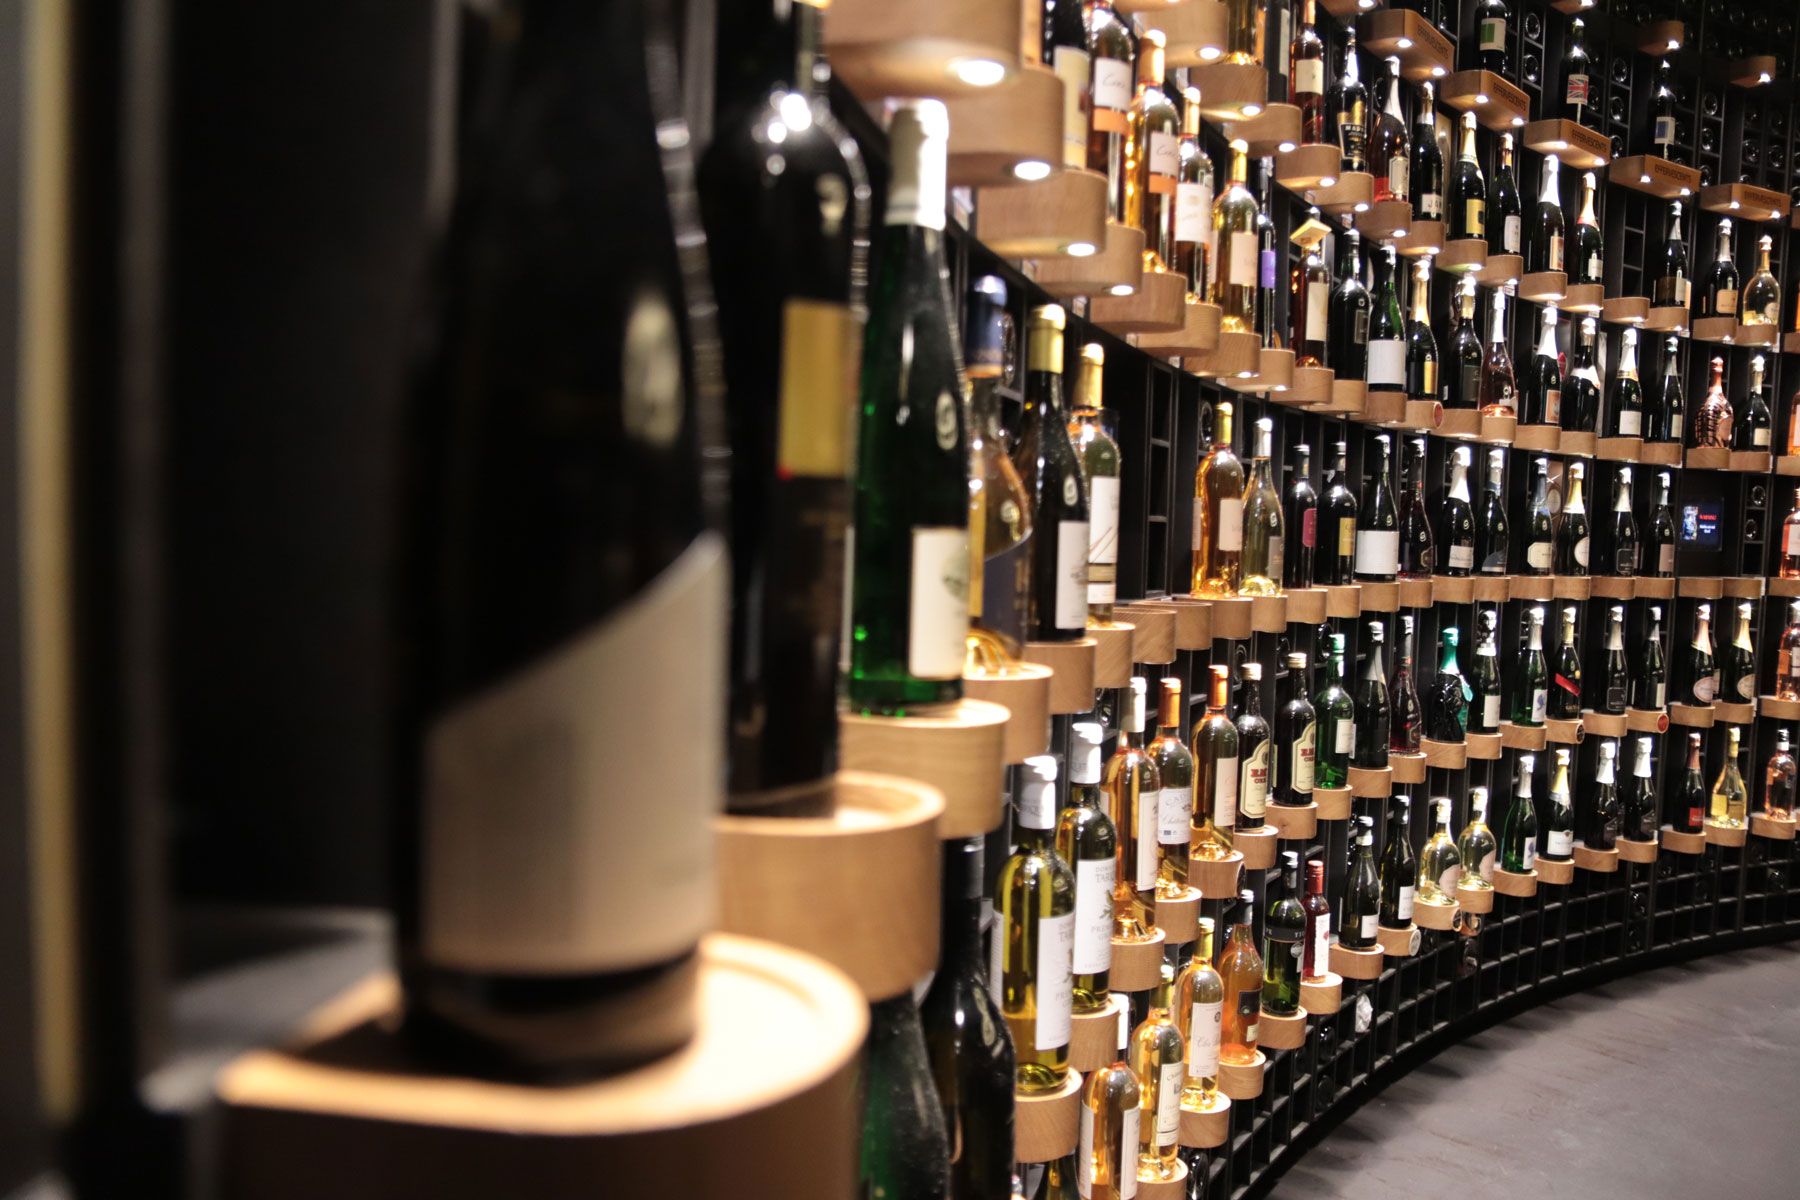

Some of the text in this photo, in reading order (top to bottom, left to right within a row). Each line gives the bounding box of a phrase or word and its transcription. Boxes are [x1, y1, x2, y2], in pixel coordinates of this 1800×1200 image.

[1494, 82, 1526, 111] EFFERVESCENTS
[1572, 129, 1607, 153] EFFERVESCENTS
[1655, 164, 1692, 183] EFFERVESCENTS
